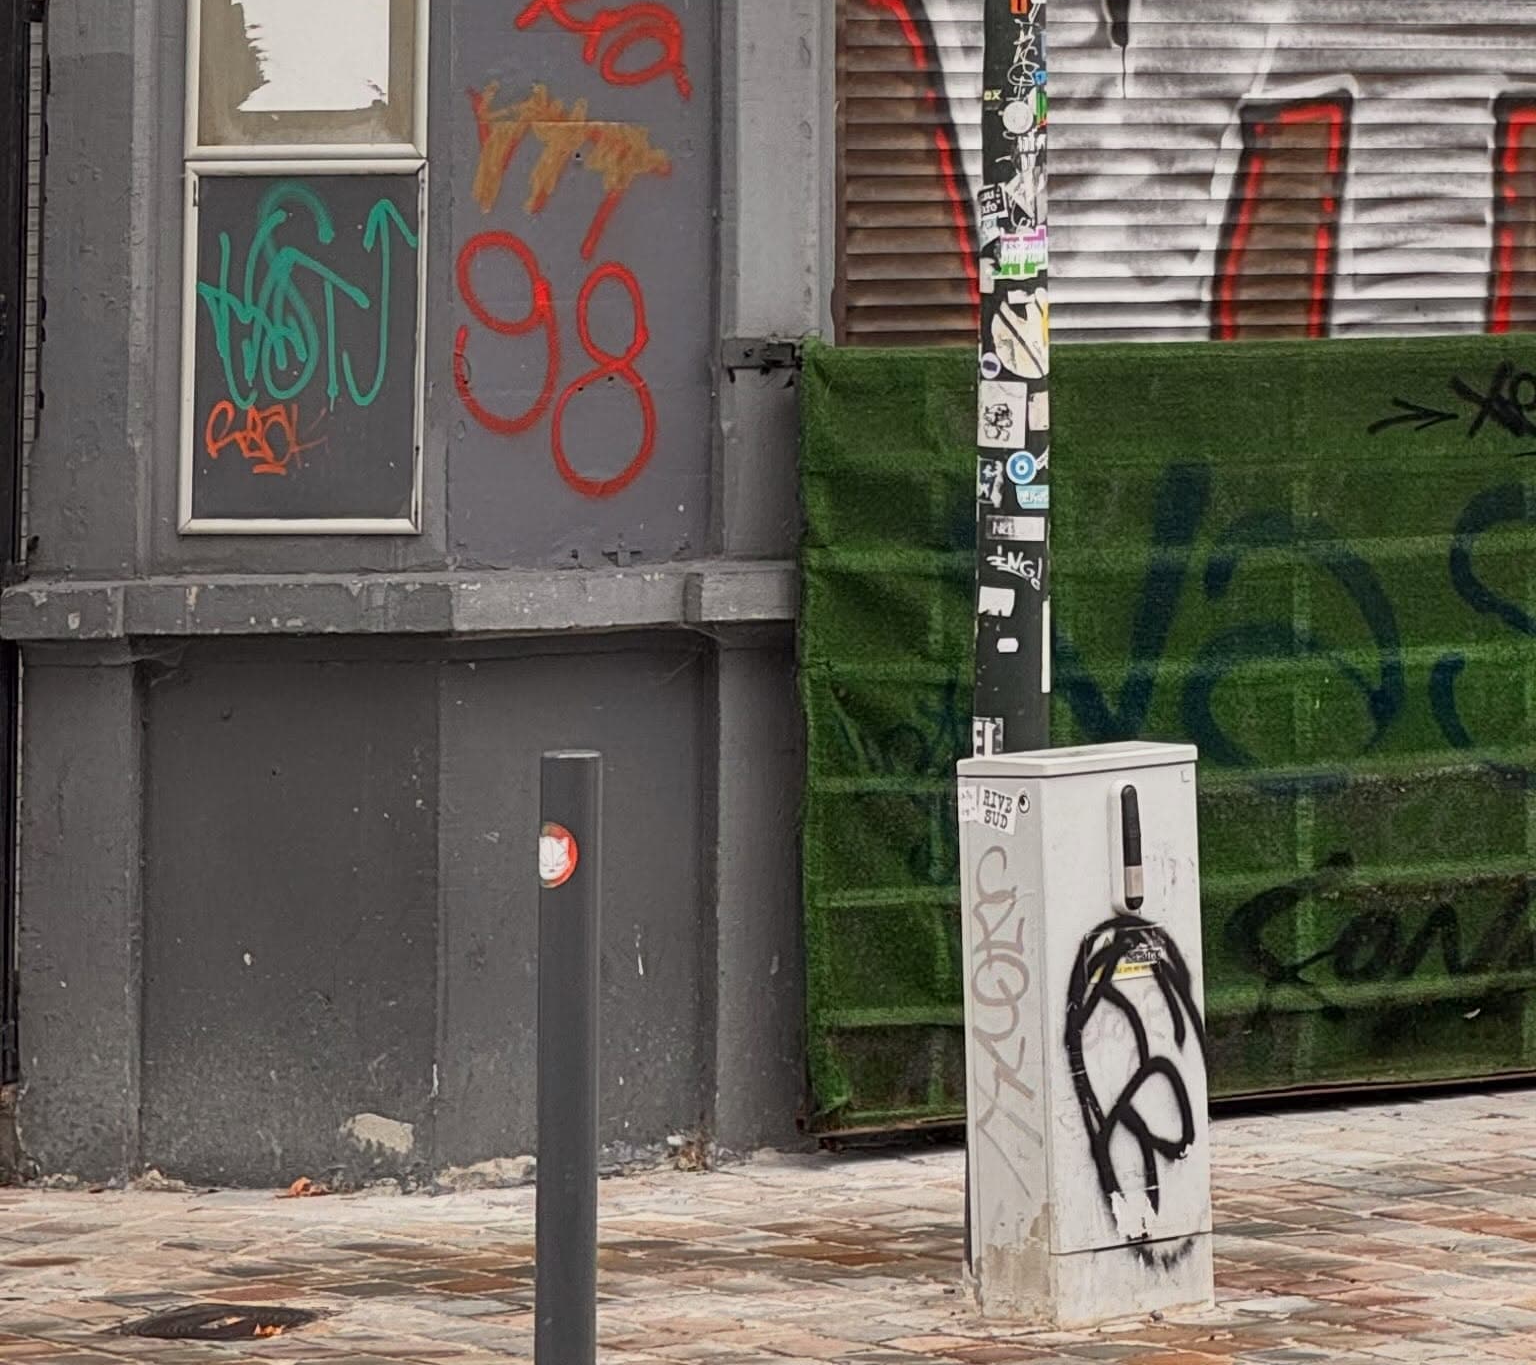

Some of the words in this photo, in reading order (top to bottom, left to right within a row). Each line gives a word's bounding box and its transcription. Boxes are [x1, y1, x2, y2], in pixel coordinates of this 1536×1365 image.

[457, 229, 656, 497] 98
[983, 789, 1013, 814] RIVE
[984, 809, 1008, 830] SUD
